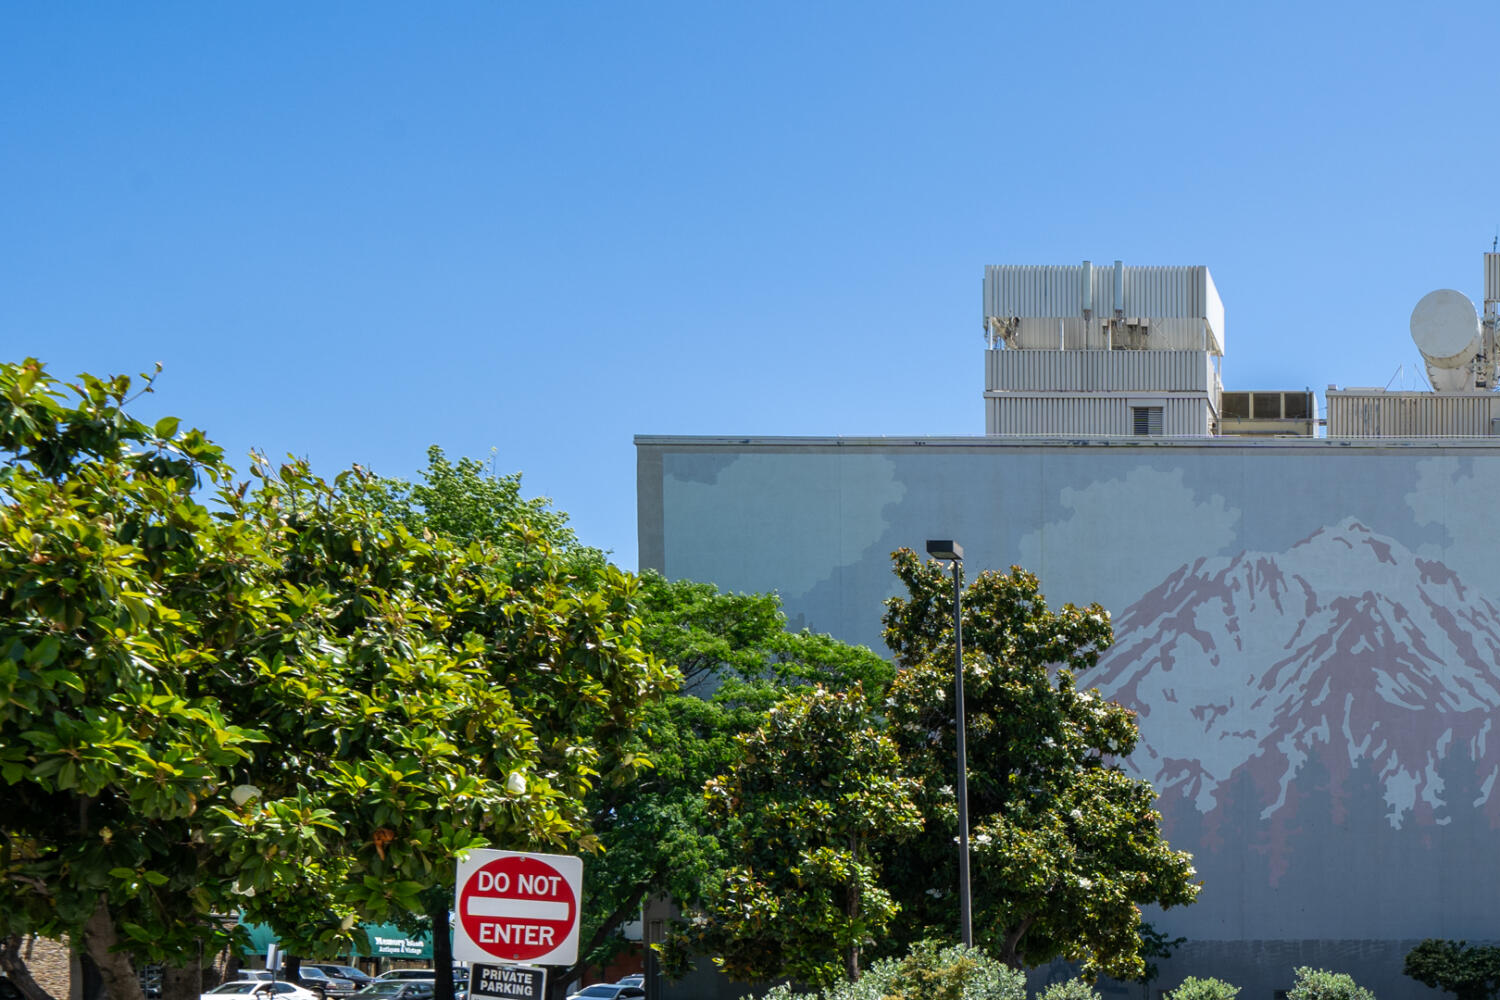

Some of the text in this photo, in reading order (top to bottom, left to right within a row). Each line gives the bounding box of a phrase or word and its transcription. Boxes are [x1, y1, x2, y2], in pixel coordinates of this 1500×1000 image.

[478, 871, 561, 896] DO NOT
[479, 922, 555, 946] ENTER
[482, 968, 533, 984] PRIVATE
[480, 980, 533, 996] PARKING
